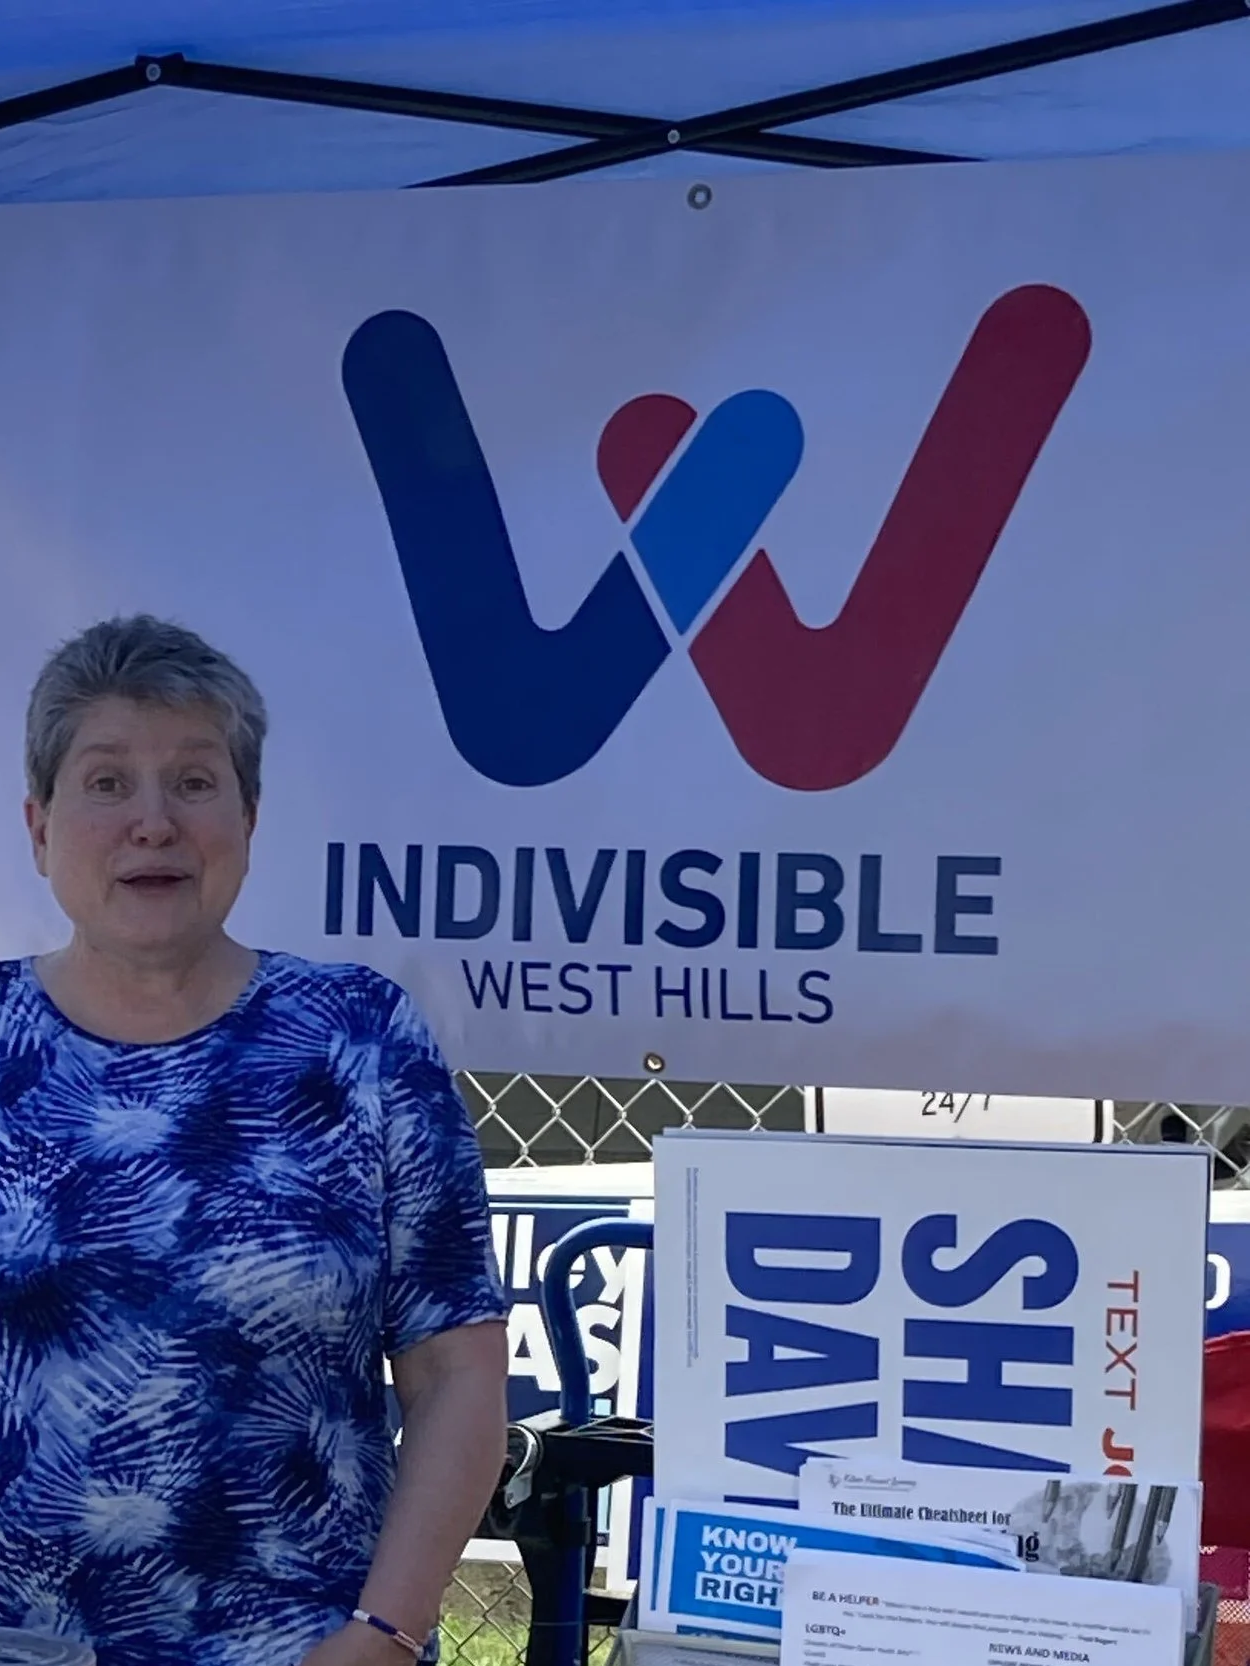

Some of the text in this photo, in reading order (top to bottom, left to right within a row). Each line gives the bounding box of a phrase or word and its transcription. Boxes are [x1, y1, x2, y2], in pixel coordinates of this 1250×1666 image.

[322, 841, 1002, 956] INDIVISIBLE
[461, 957, 835, 1025] WEST HILLS
[1103, 1269, 1139, 1412] TEXT
[832, 1501, 856, 1517] The
[860, 1503, 914, 1520] Ultimate
[992, 1510, 1012, 1526] for
[701, 1525, 798, 1556] KNOW
[701, 1551, 785, 1583] YOUR
[701, 1577, 785, 1607] RIGH
[989, 1643, 1090, 1664] NEWS AND MEDIA
